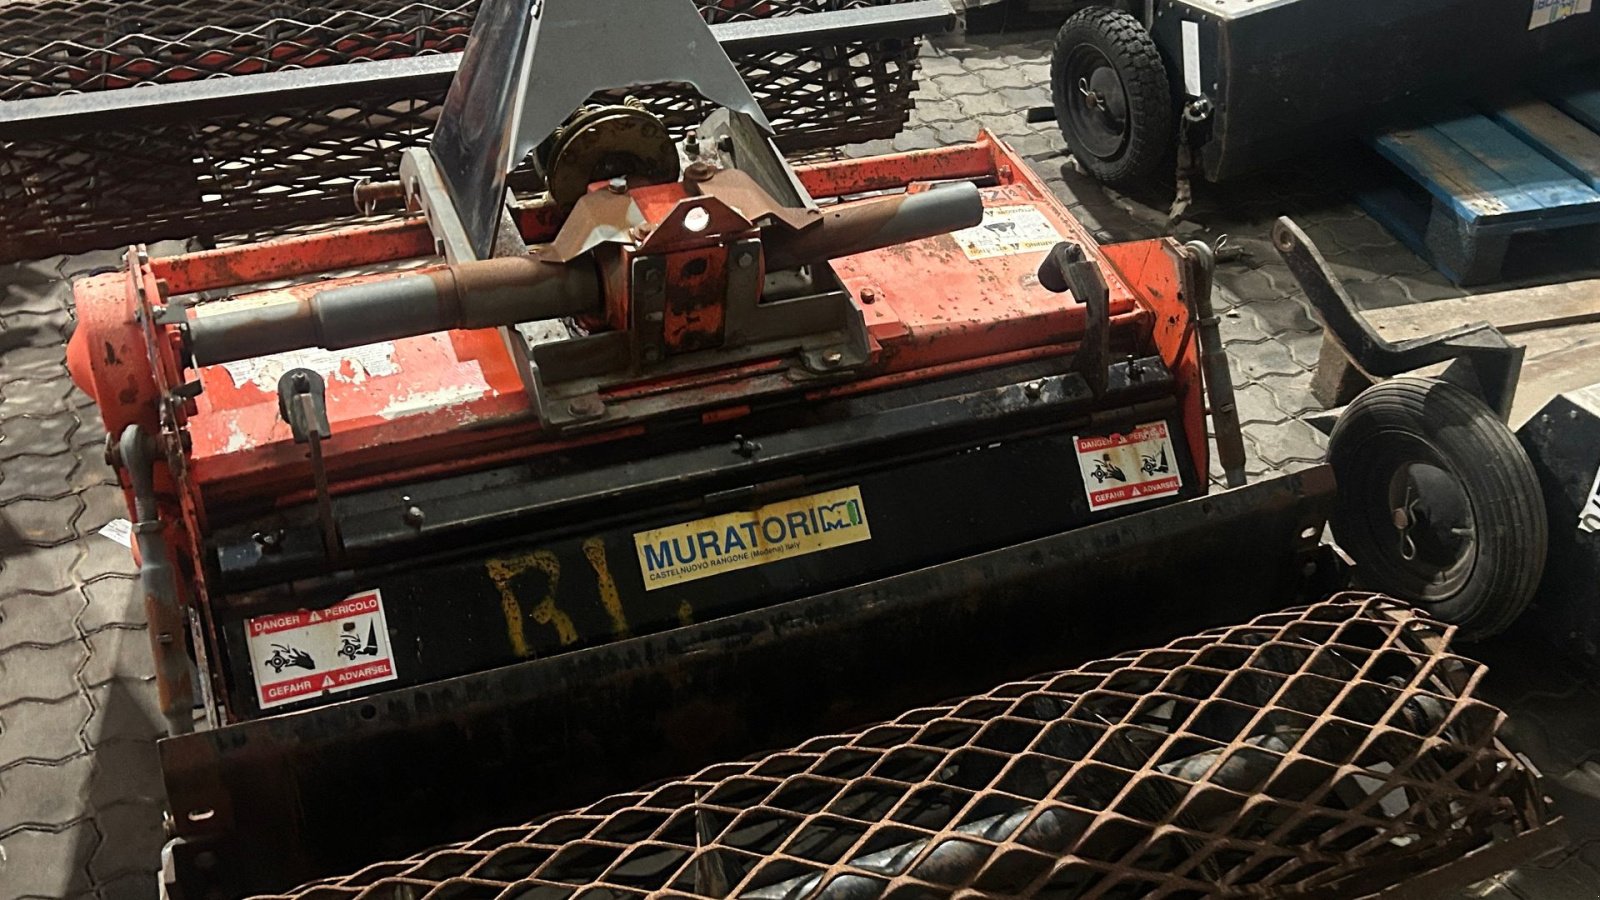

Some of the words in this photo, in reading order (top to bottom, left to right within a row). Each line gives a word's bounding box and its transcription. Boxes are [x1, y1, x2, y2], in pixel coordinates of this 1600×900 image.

[1080, 436, 1113, 450] DANGER
[1095, 490, 1125, 502] GEFAHR
[1143, 481, 1179, 493] ADVARSEL
[643, 507, 819, 571] MURATORI
[650, 561, 709, 581] CASTELNUOVO
[710, 551, 749, 567] RANGONE
[750, 543, 784, 561] (Modena)
[785, 541, 801, 551] Italy
[254, 615, 300, 632] DANGER
[324, 599, 377, 618] PERICOLO
[268, 680, 312, 697] GEFAHR
[338, 664, 391, 682] ADVARSEL
